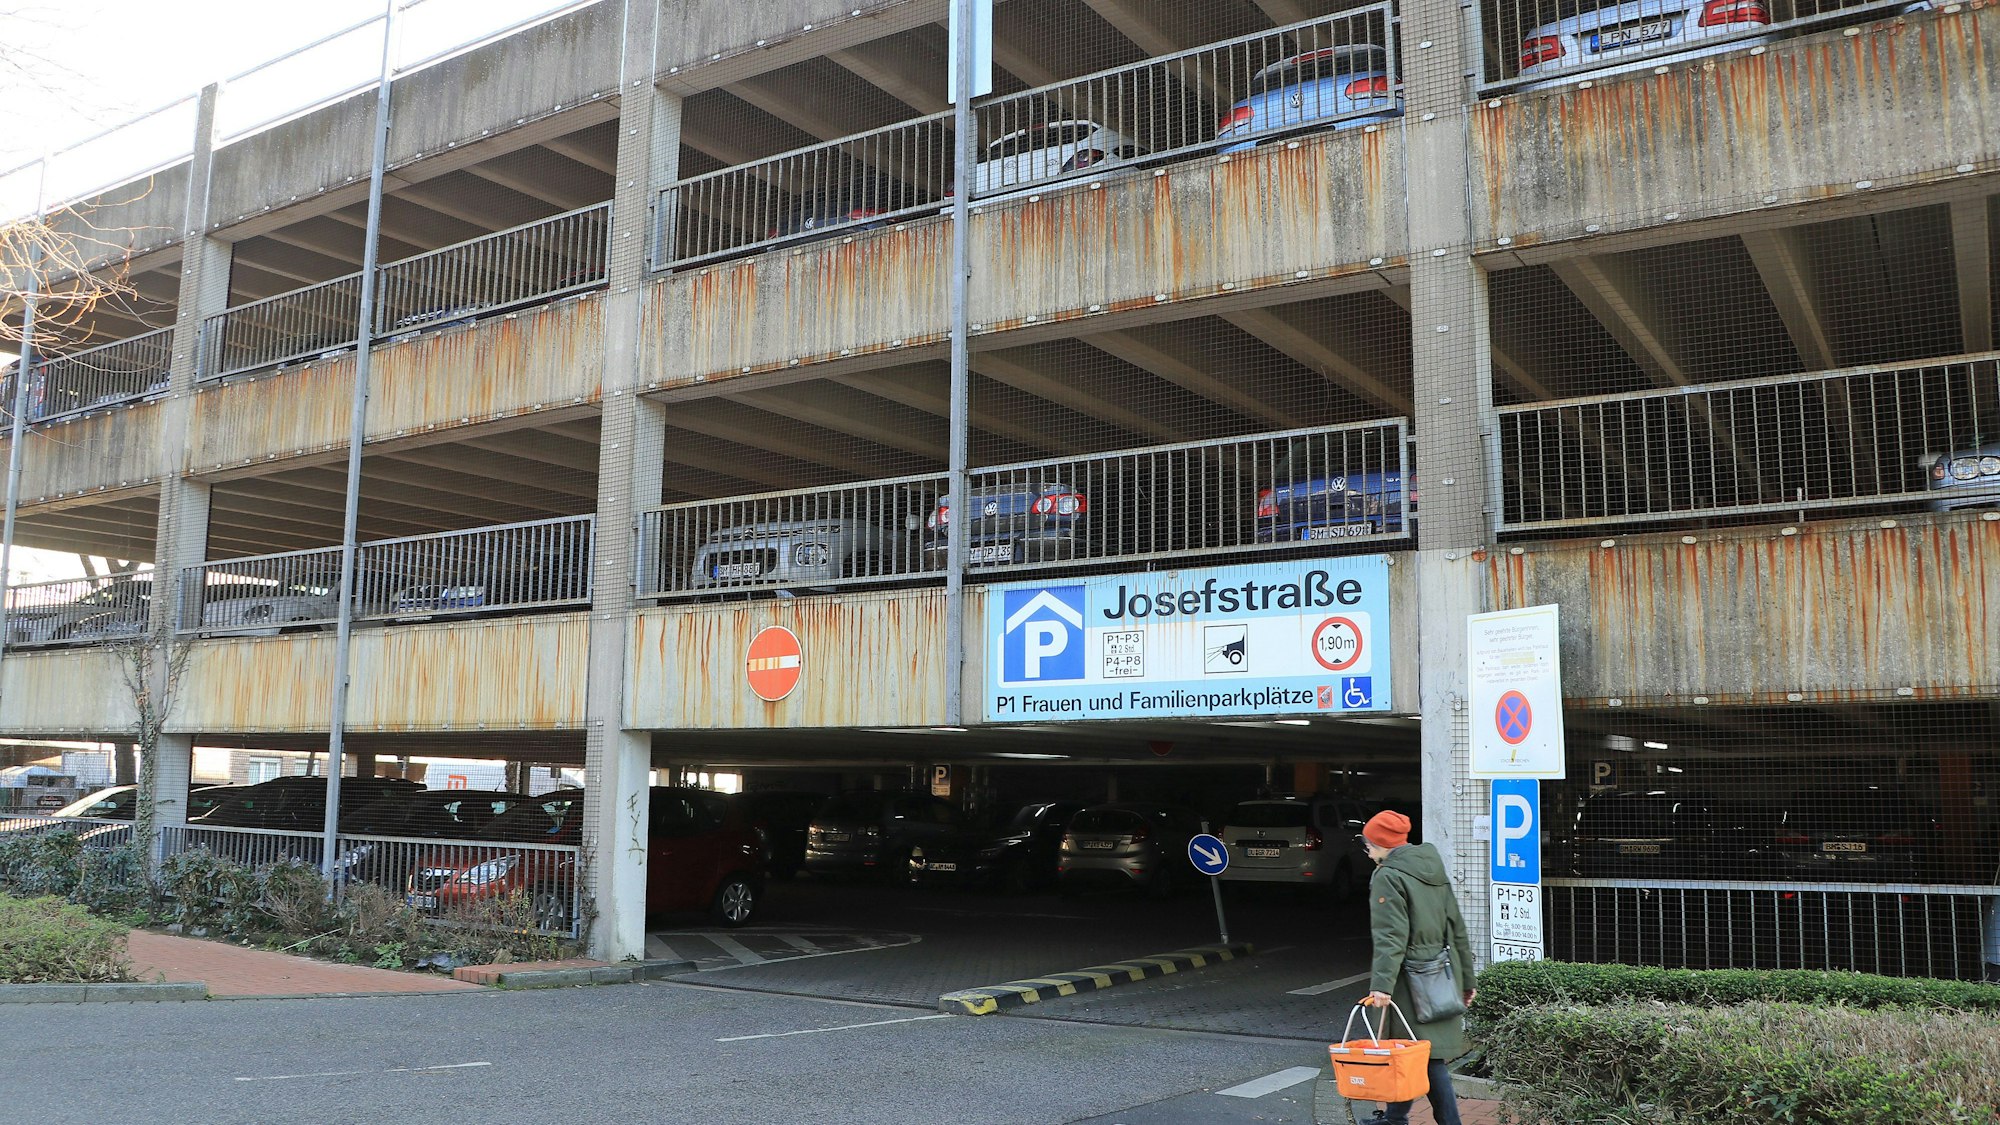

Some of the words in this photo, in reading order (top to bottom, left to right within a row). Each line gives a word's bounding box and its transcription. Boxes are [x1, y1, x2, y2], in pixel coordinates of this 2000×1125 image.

[1103, 570, 1362, 620] Josefstraße
[1107, 633, 1140, 645] P1-P3
[1025, 620, 1068, 678] P
[1118, 644, 1123, 654] 2
[1106, 655, 1141, 667] P4-P8
[997, 696, 1016, 714] P1
[1023, 695, 1082, 713] Frauen
[1089, 691, 1123, 711] und
[1130, 686, 1313, 711] Familienparkplätze
[935, 766, 947, 784] P
[1594, 762, 1611, 784] P
[1497, 794, 1533, 867] P
[1497, 888, 1533, 903] P1-P3
[1513, 906, 1518, 918] 2
[1498, 945, 1536, 961] P4-P8
